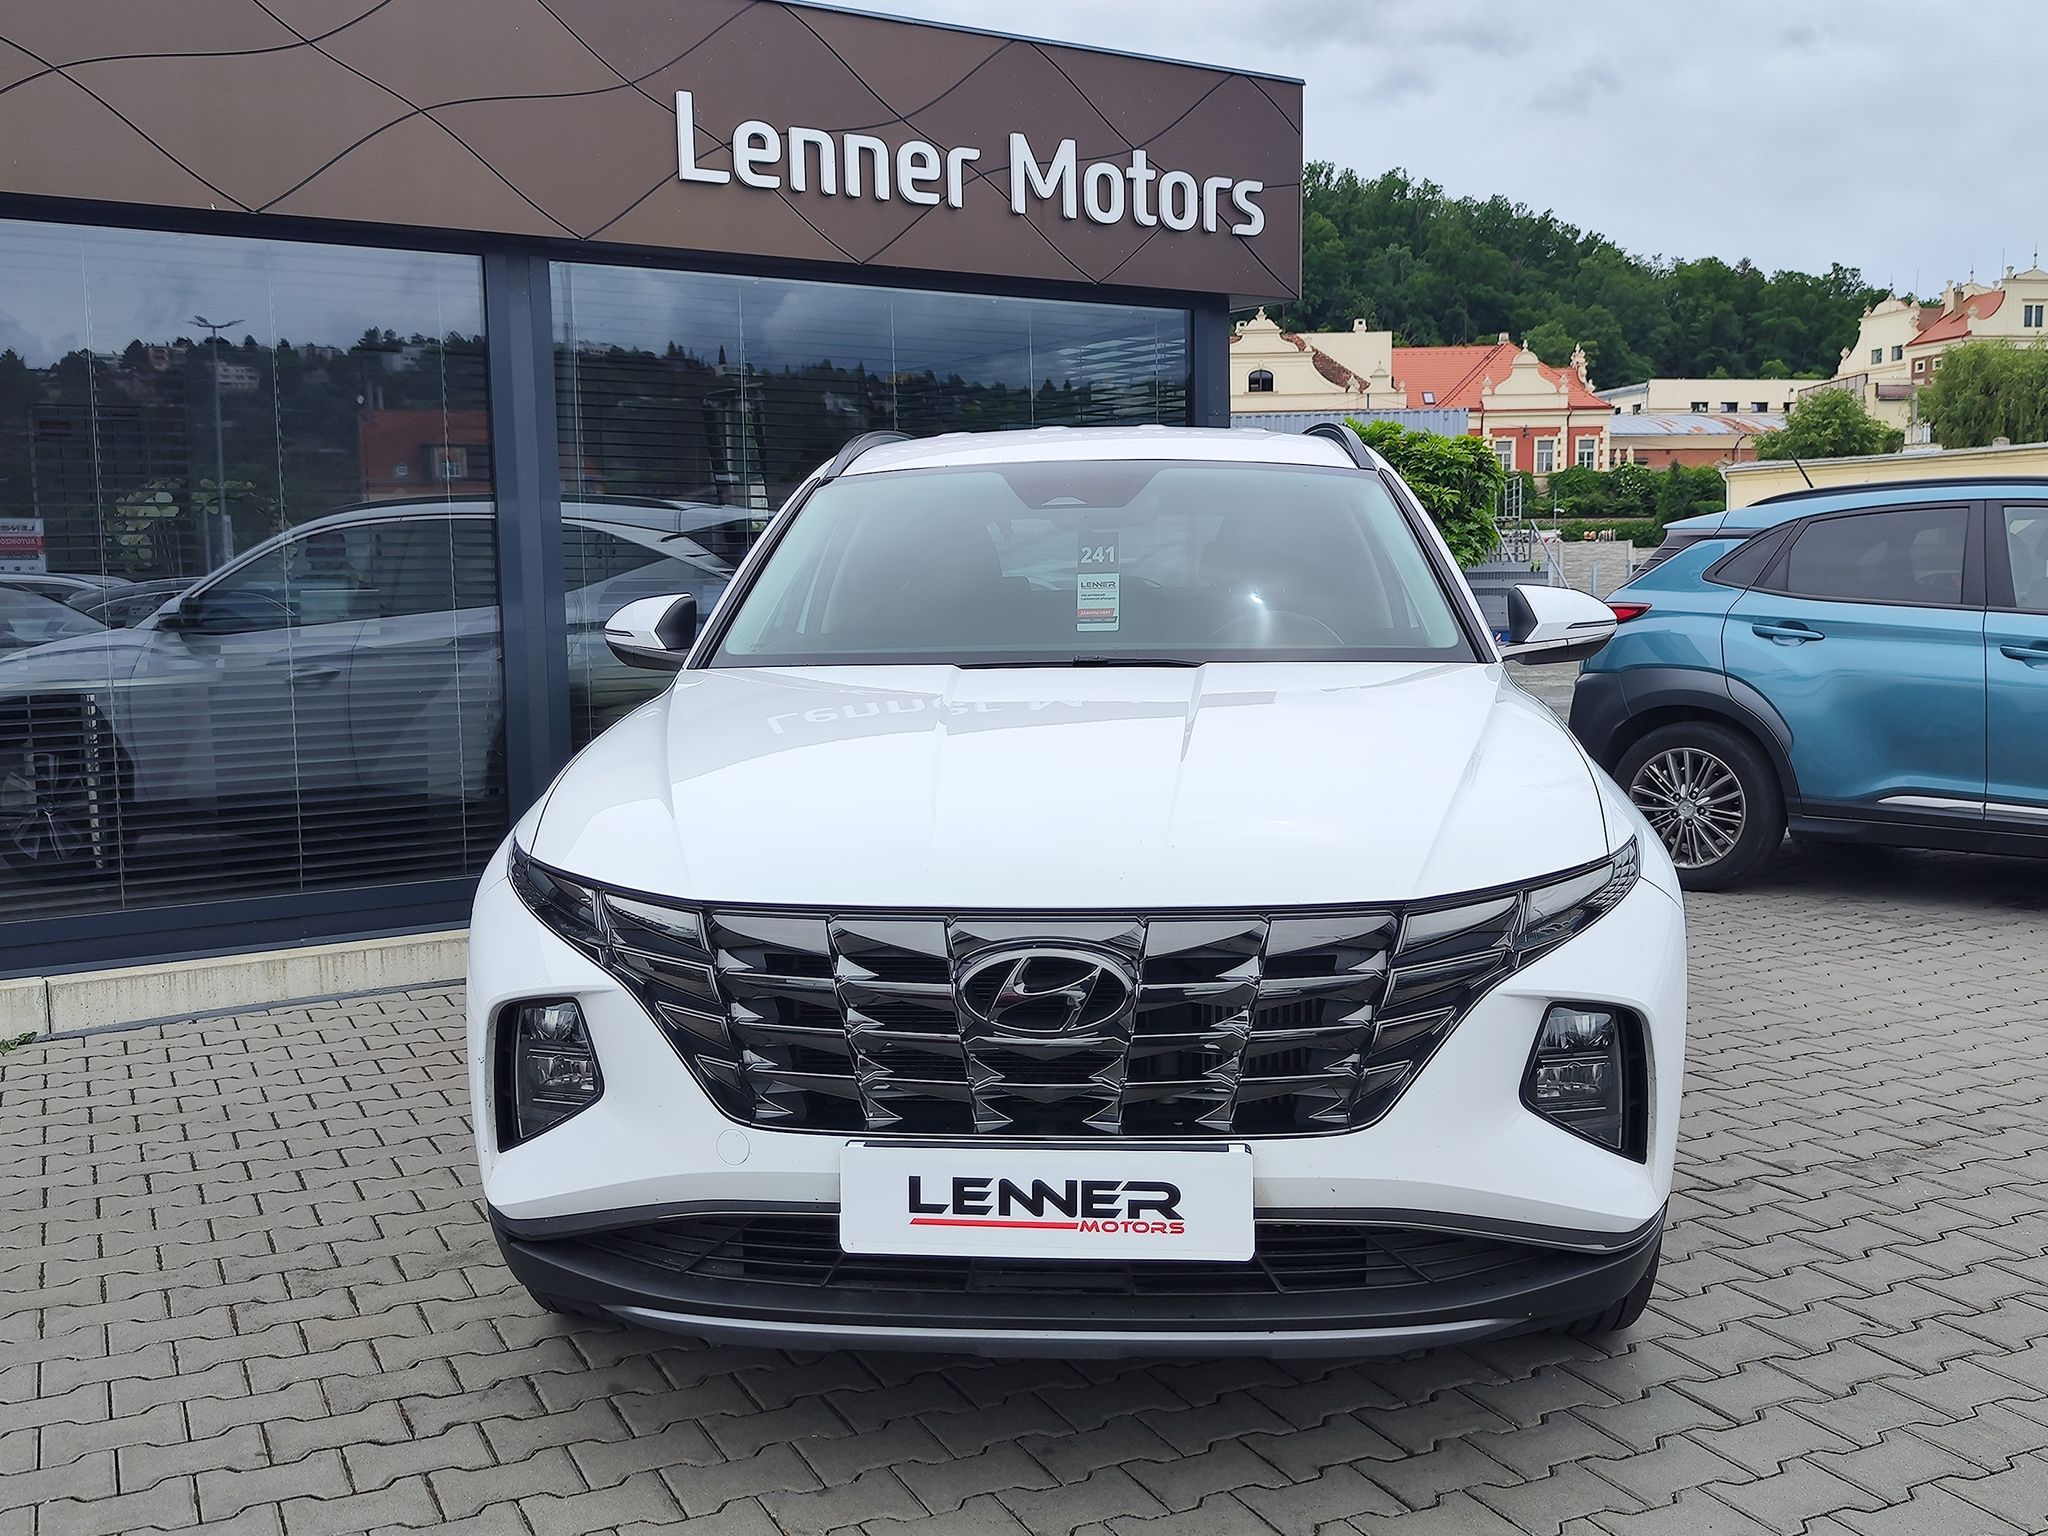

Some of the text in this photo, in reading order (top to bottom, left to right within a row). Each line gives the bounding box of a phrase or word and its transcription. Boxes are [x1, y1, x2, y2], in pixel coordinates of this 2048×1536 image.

[676, 90, 1266, 237] Lenner Motors
[1081, 545, 1115, 564] 241
[908, 1175, 1185, 1220] LENNER
[1079, 1220, 1186, 1236] MOTORS
